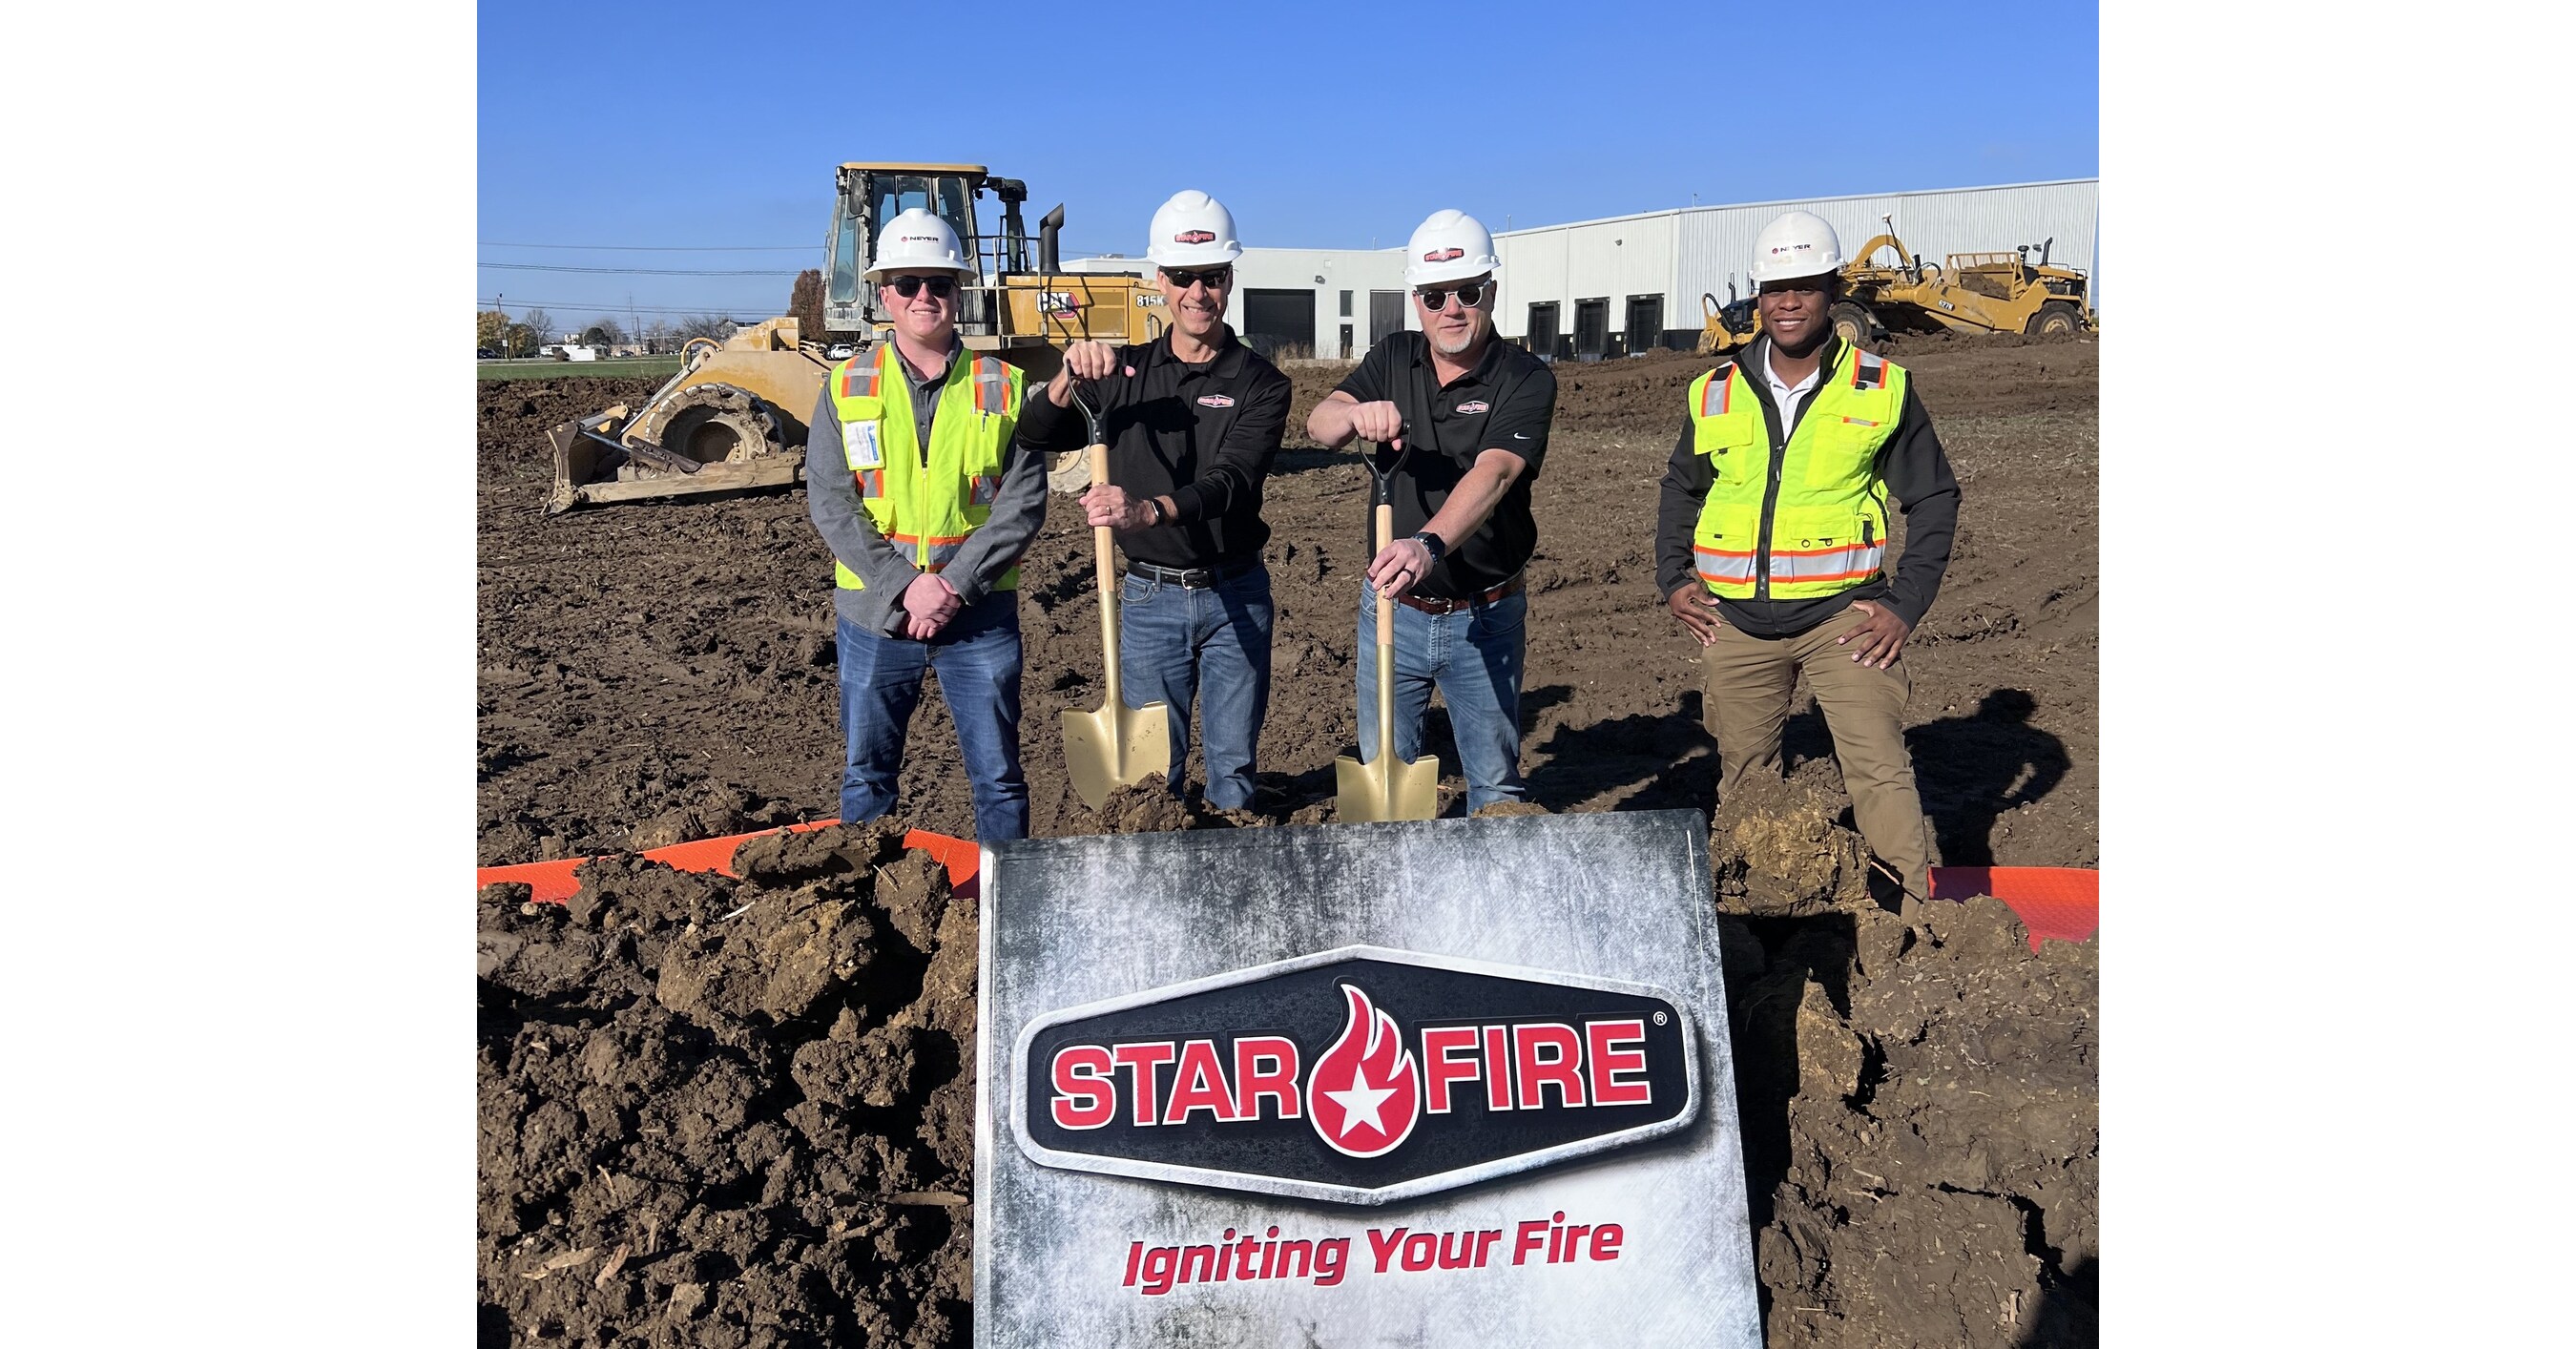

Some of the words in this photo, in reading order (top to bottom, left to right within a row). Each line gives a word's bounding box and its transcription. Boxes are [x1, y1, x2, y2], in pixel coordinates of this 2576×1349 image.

[1780, 243, 1811, 252] NYER
[1051, 1036, 1301, 1130] STAR
[1421, 1019, 1652, 1114] FIRE
[1123, 1225, 1351, 1295] Igniting
[1366, 1227, 1503, 1274] Your
[1512, 1210, 1624, 1266] Fire
